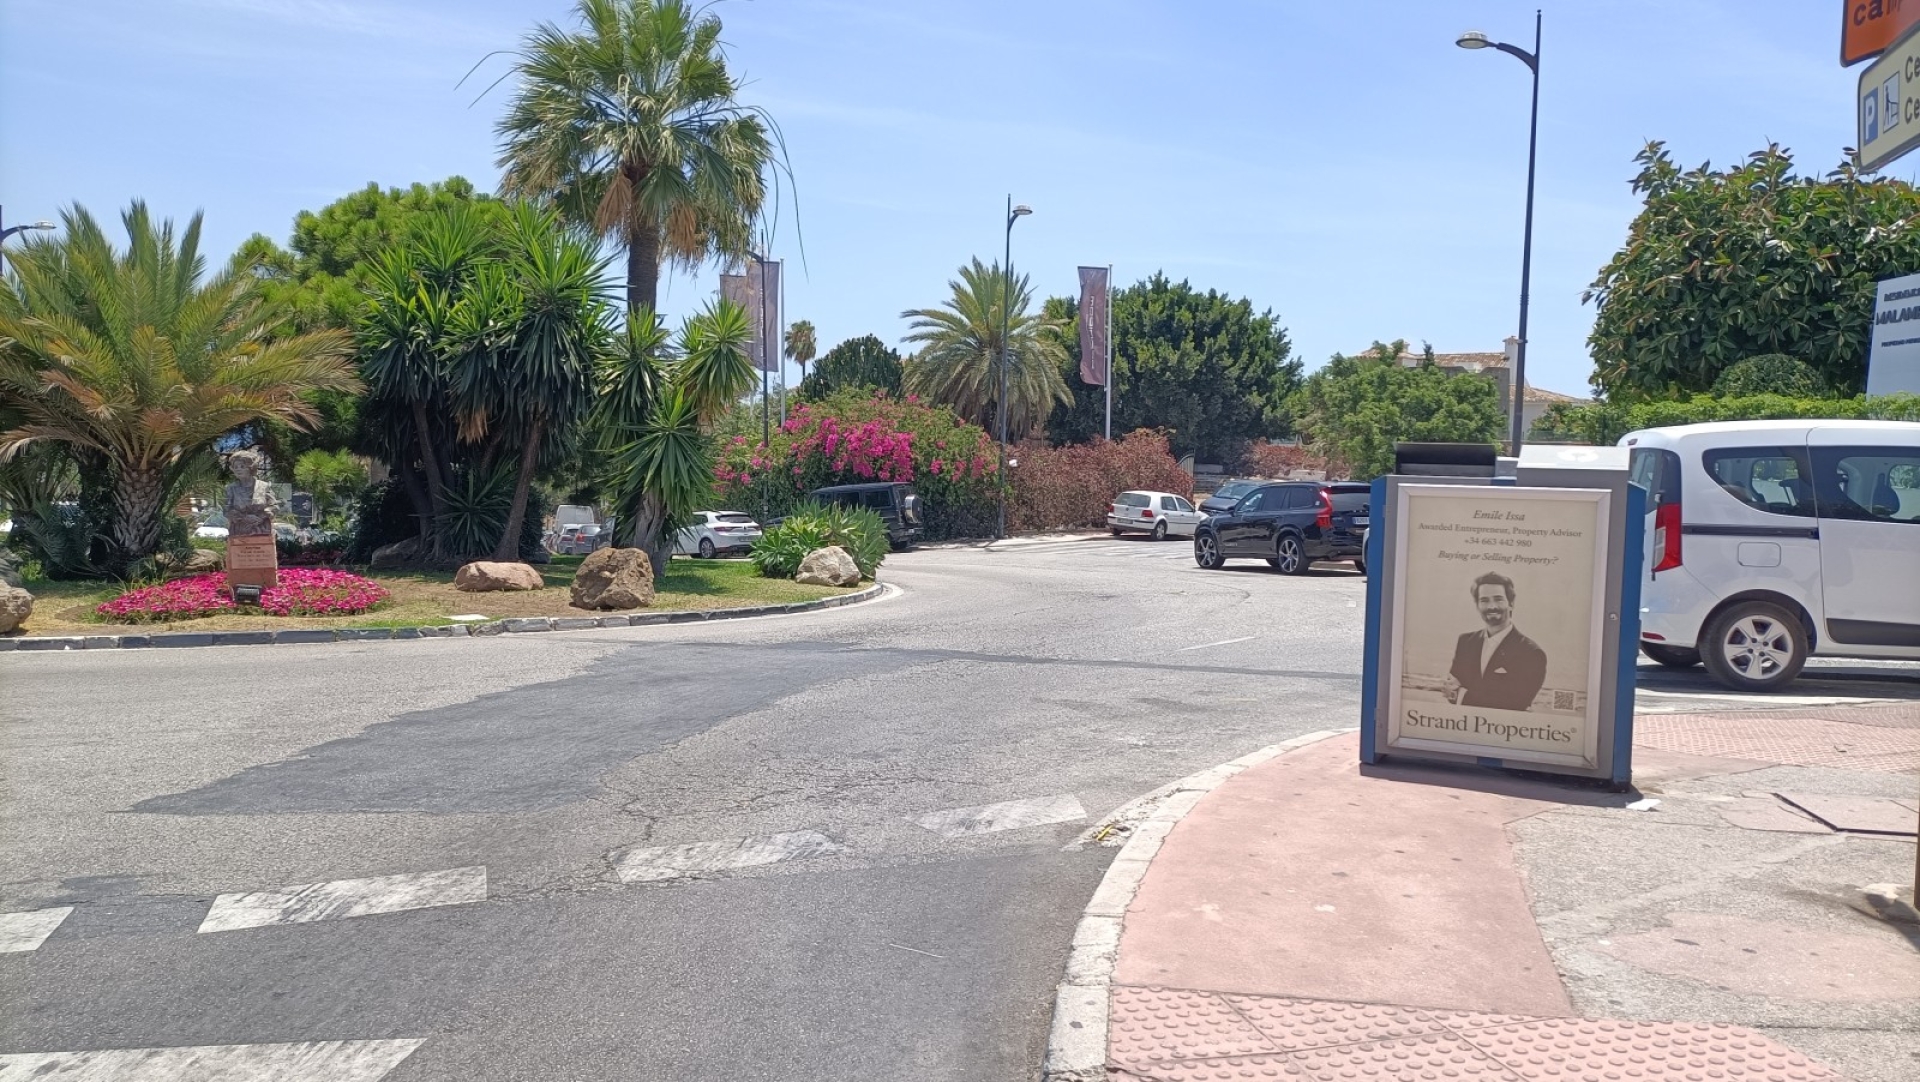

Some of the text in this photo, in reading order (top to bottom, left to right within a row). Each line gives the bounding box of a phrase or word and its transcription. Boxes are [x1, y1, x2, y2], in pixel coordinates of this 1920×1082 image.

[1473, 510, 1526, 521] Emile Issa
[1418, 523, 1582, 537] Awarded Entrepreneur, Property Advisor
[1464, 537, 1479, 545] +34
[1481, 538, 1497, 546] 663
[1438, 551, 1470, 561] Buying
[1482, 553, 1512, 564] Selling
[1513, 555, 1560, 566] Property?
[1406, 709, 1467, 732] Strand
